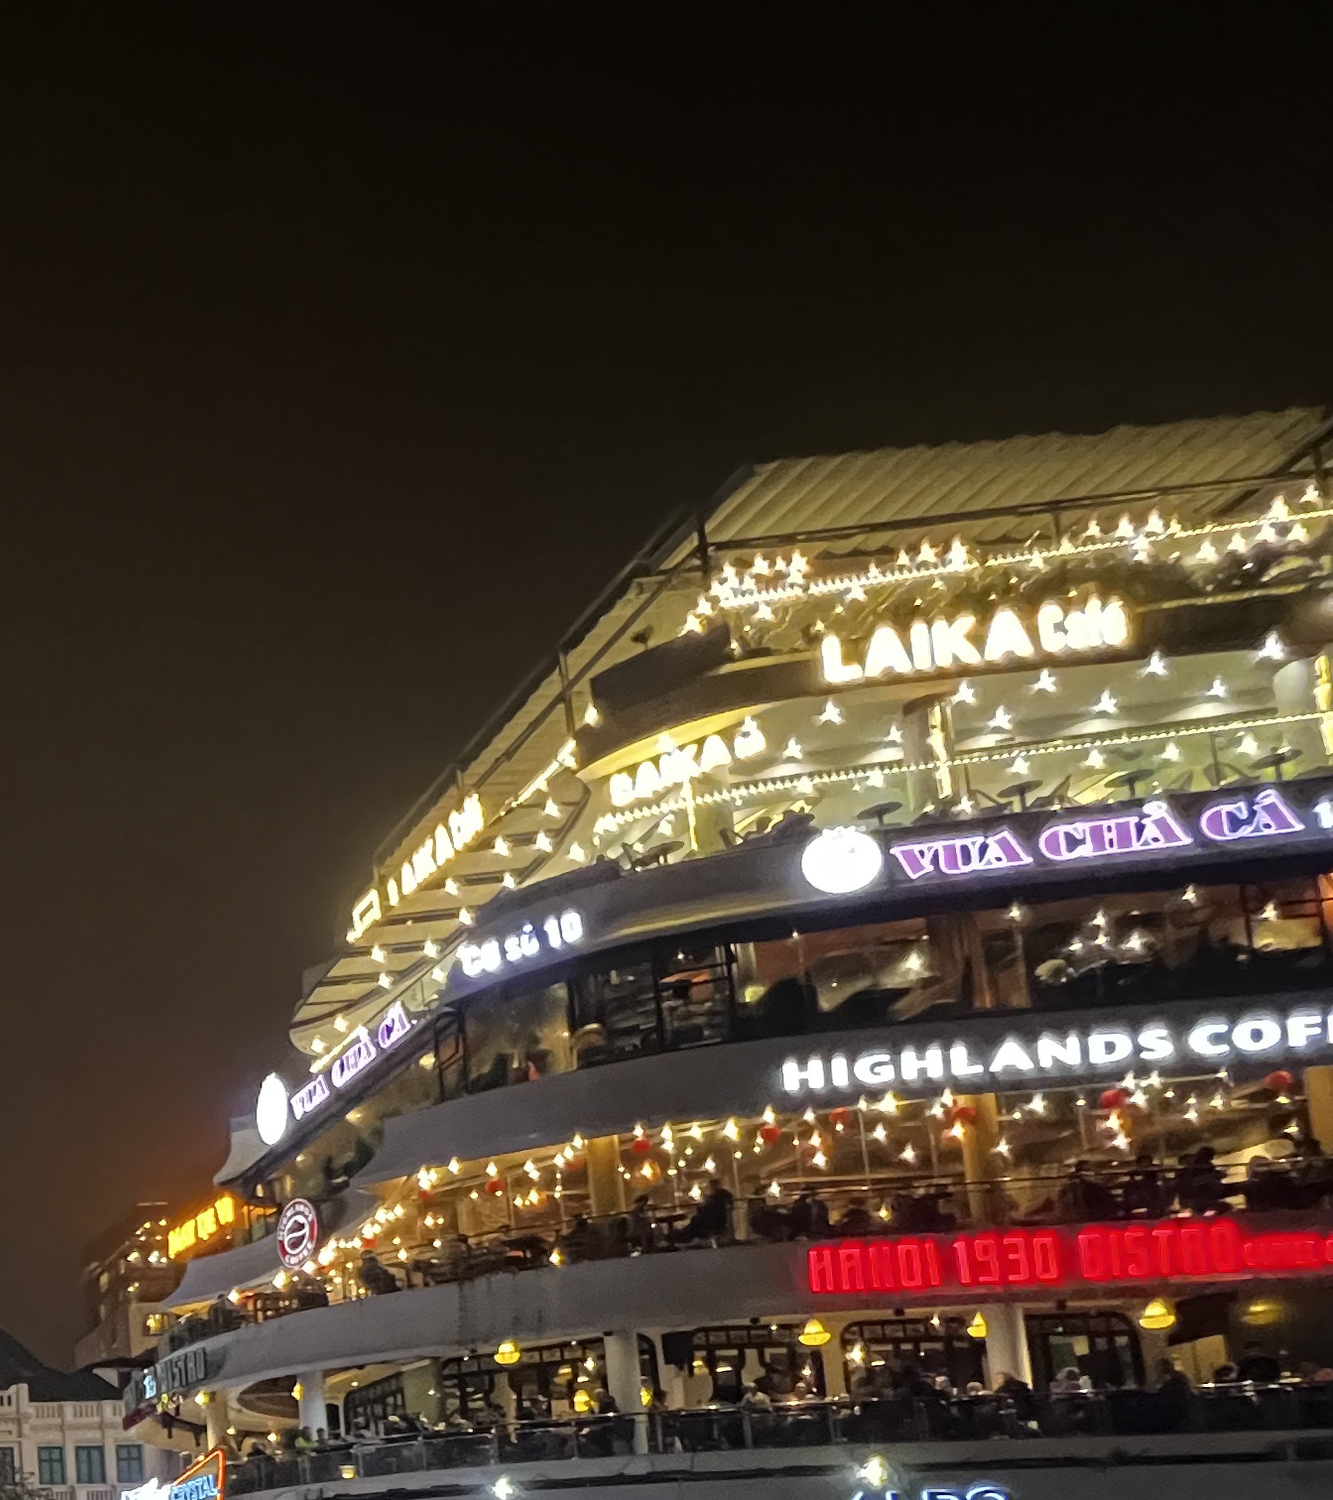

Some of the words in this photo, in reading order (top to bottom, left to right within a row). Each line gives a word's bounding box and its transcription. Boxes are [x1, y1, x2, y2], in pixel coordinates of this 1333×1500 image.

[820, 606, 1035, 682] LAIKA
[890, 829, 1033, 880] VUA
[544, 907, 584, 951] 10
[781, 1026, 1172, 1094] HIGHLANDS
[807, 1239, 942, 1294] HANOI
[952, 1232, 1061, 1287] 1930
[1077, 1220, 1241, 1282] BISTRO
